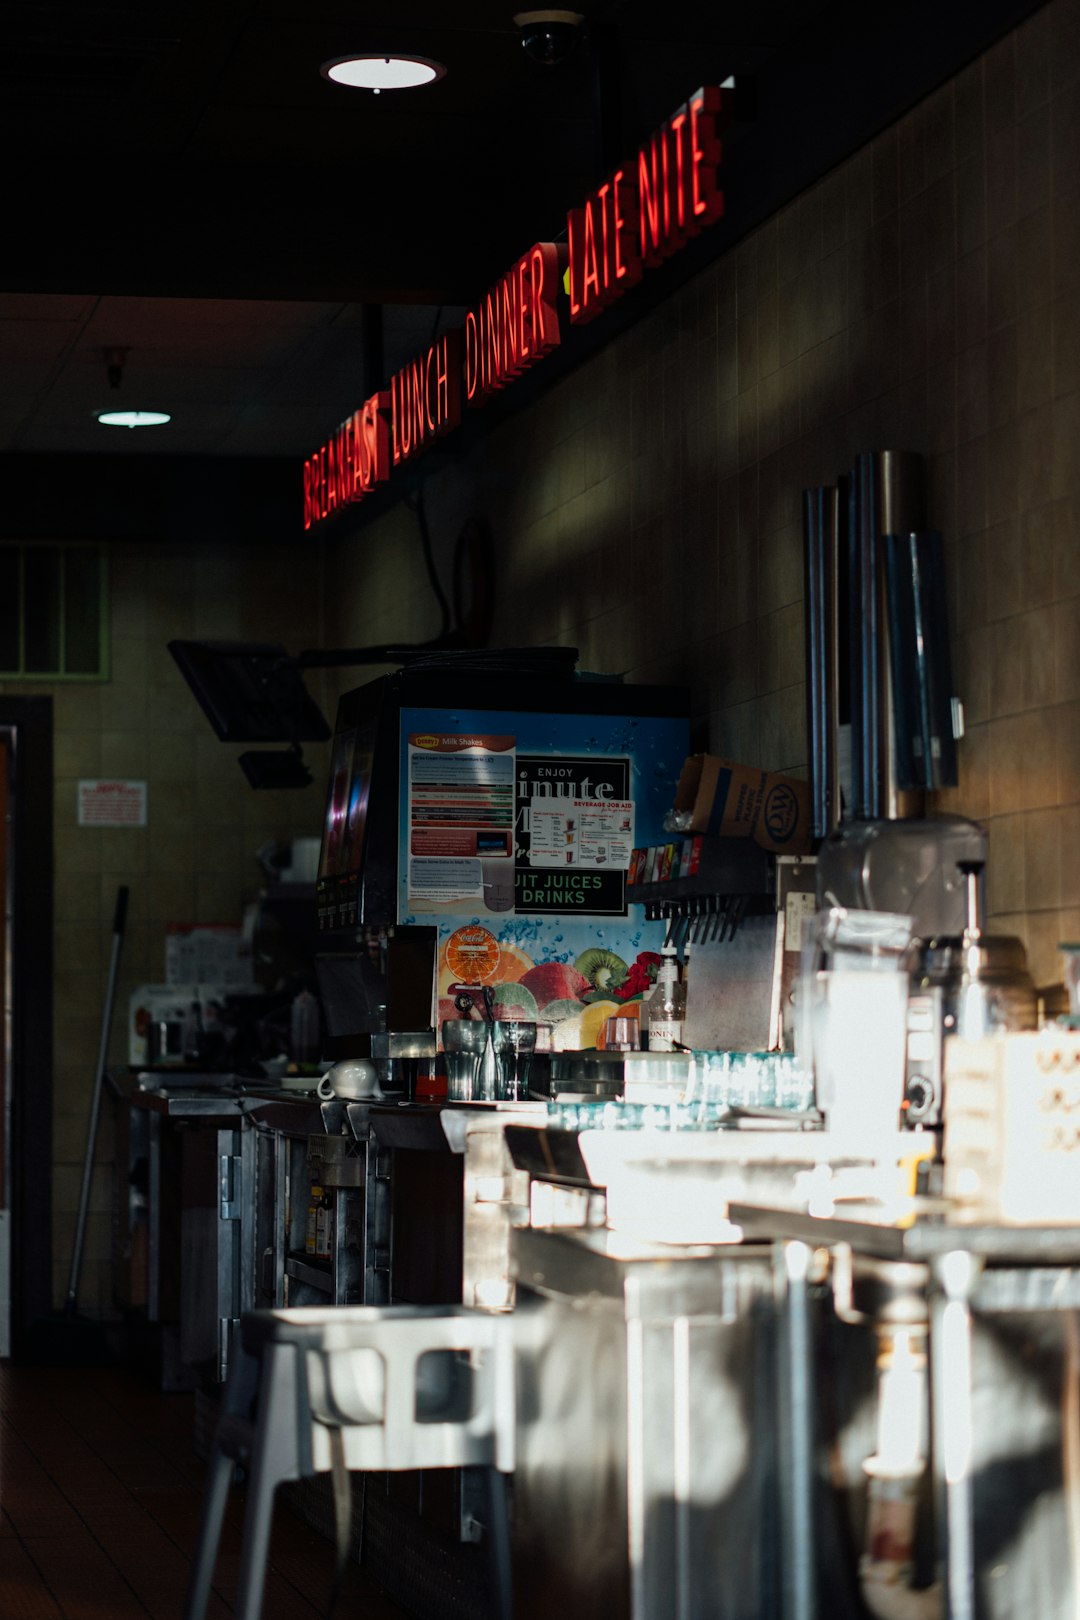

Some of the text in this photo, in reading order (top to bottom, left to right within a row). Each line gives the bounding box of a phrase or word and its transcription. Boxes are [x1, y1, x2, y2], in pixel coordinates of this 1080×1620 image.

[303, 97, 708, 531] BREAKFAST LUNCH DINNER LATE NITE
[458, 738, 483, 747] Shakes
[537, 768, 573, 777] ENJOY
[543, 875, 603, 889] JUICES
[522, 890, 586, 904] DRINKS
